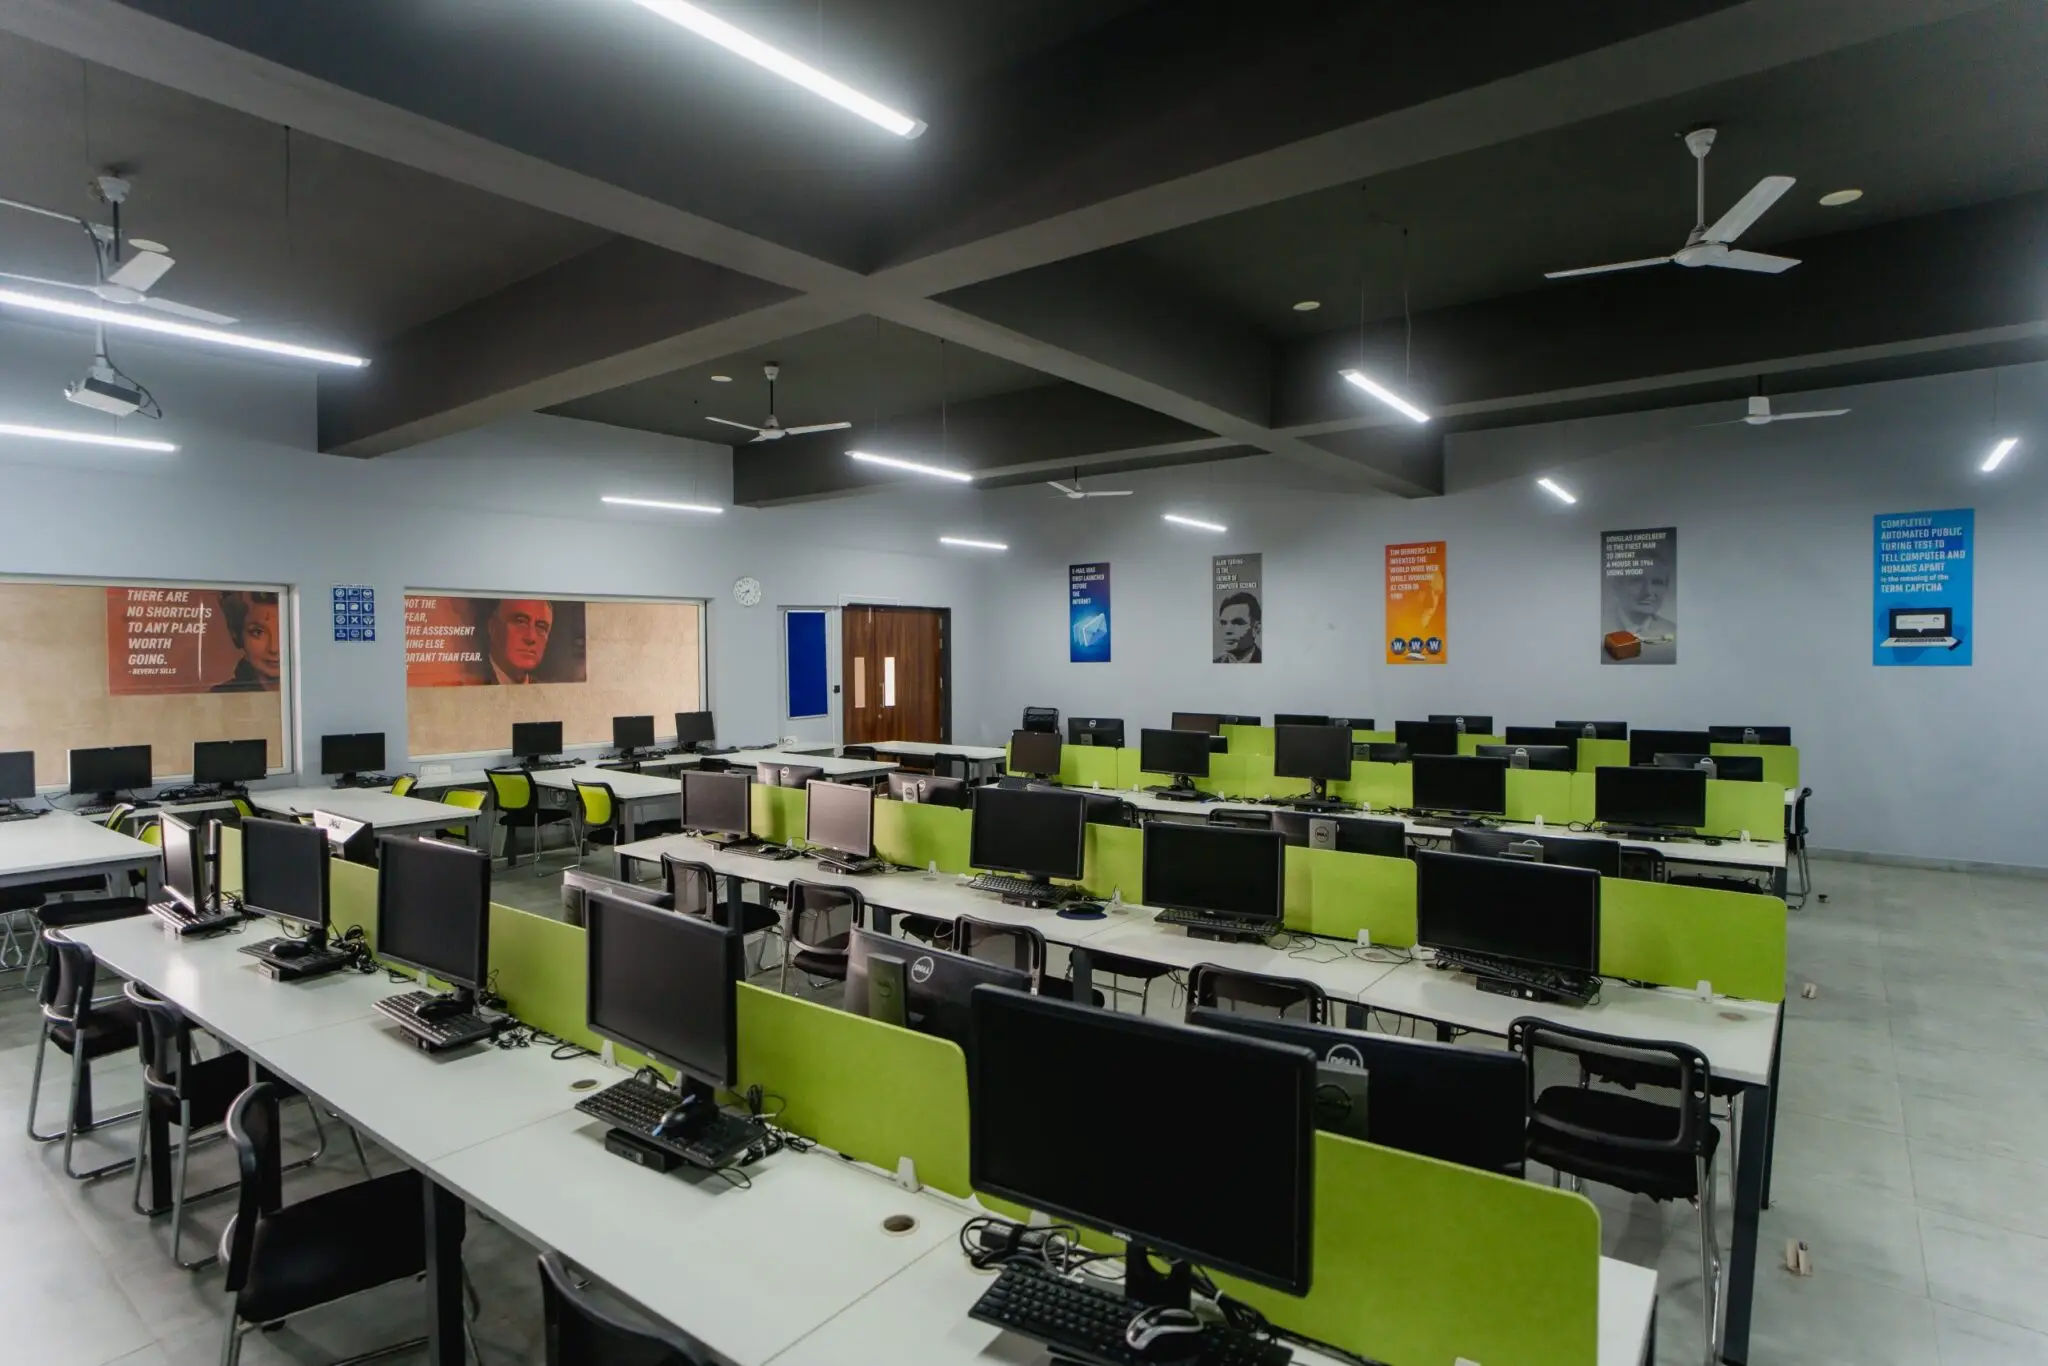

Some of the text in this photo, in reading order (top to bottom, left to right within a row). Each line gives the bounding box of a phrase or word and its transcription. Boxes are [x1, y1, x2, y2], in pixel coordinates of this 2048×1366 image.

[1881, 517, 1932, 528] COMPLETELY
[1881, 527, 1963, 540] AUTOMATED PUBLIC
[1642, 541, 1656, 549] MAN
[1881, 539, 1945, 551] TURING TEST TO
[1881, 550, 1966, 562] TELL COMPUTER AND
[1625, 568, 1643, 576] WOOD
[1881, 562, 1945, 574] HUMANS APART
[1881, 583, 1943, 593] TERM CAPTCHA
[128, 589, 189, 602] THERE ARE
[422, 599, 437, 609] THE
[127, 606, 144, 617] NO
[128, 622, 207, 634] TO ANY PLACE
[406, 626, 476, 636] THE ASSESSMENT
[128, 638, 173, 649] WORTH
[425, 639, 445, 649] ELSE
[128, 653, 168, 665] GOING.
[438, 652, 460, 662] THAN
[460, 652, 483, 662] FEAR.
